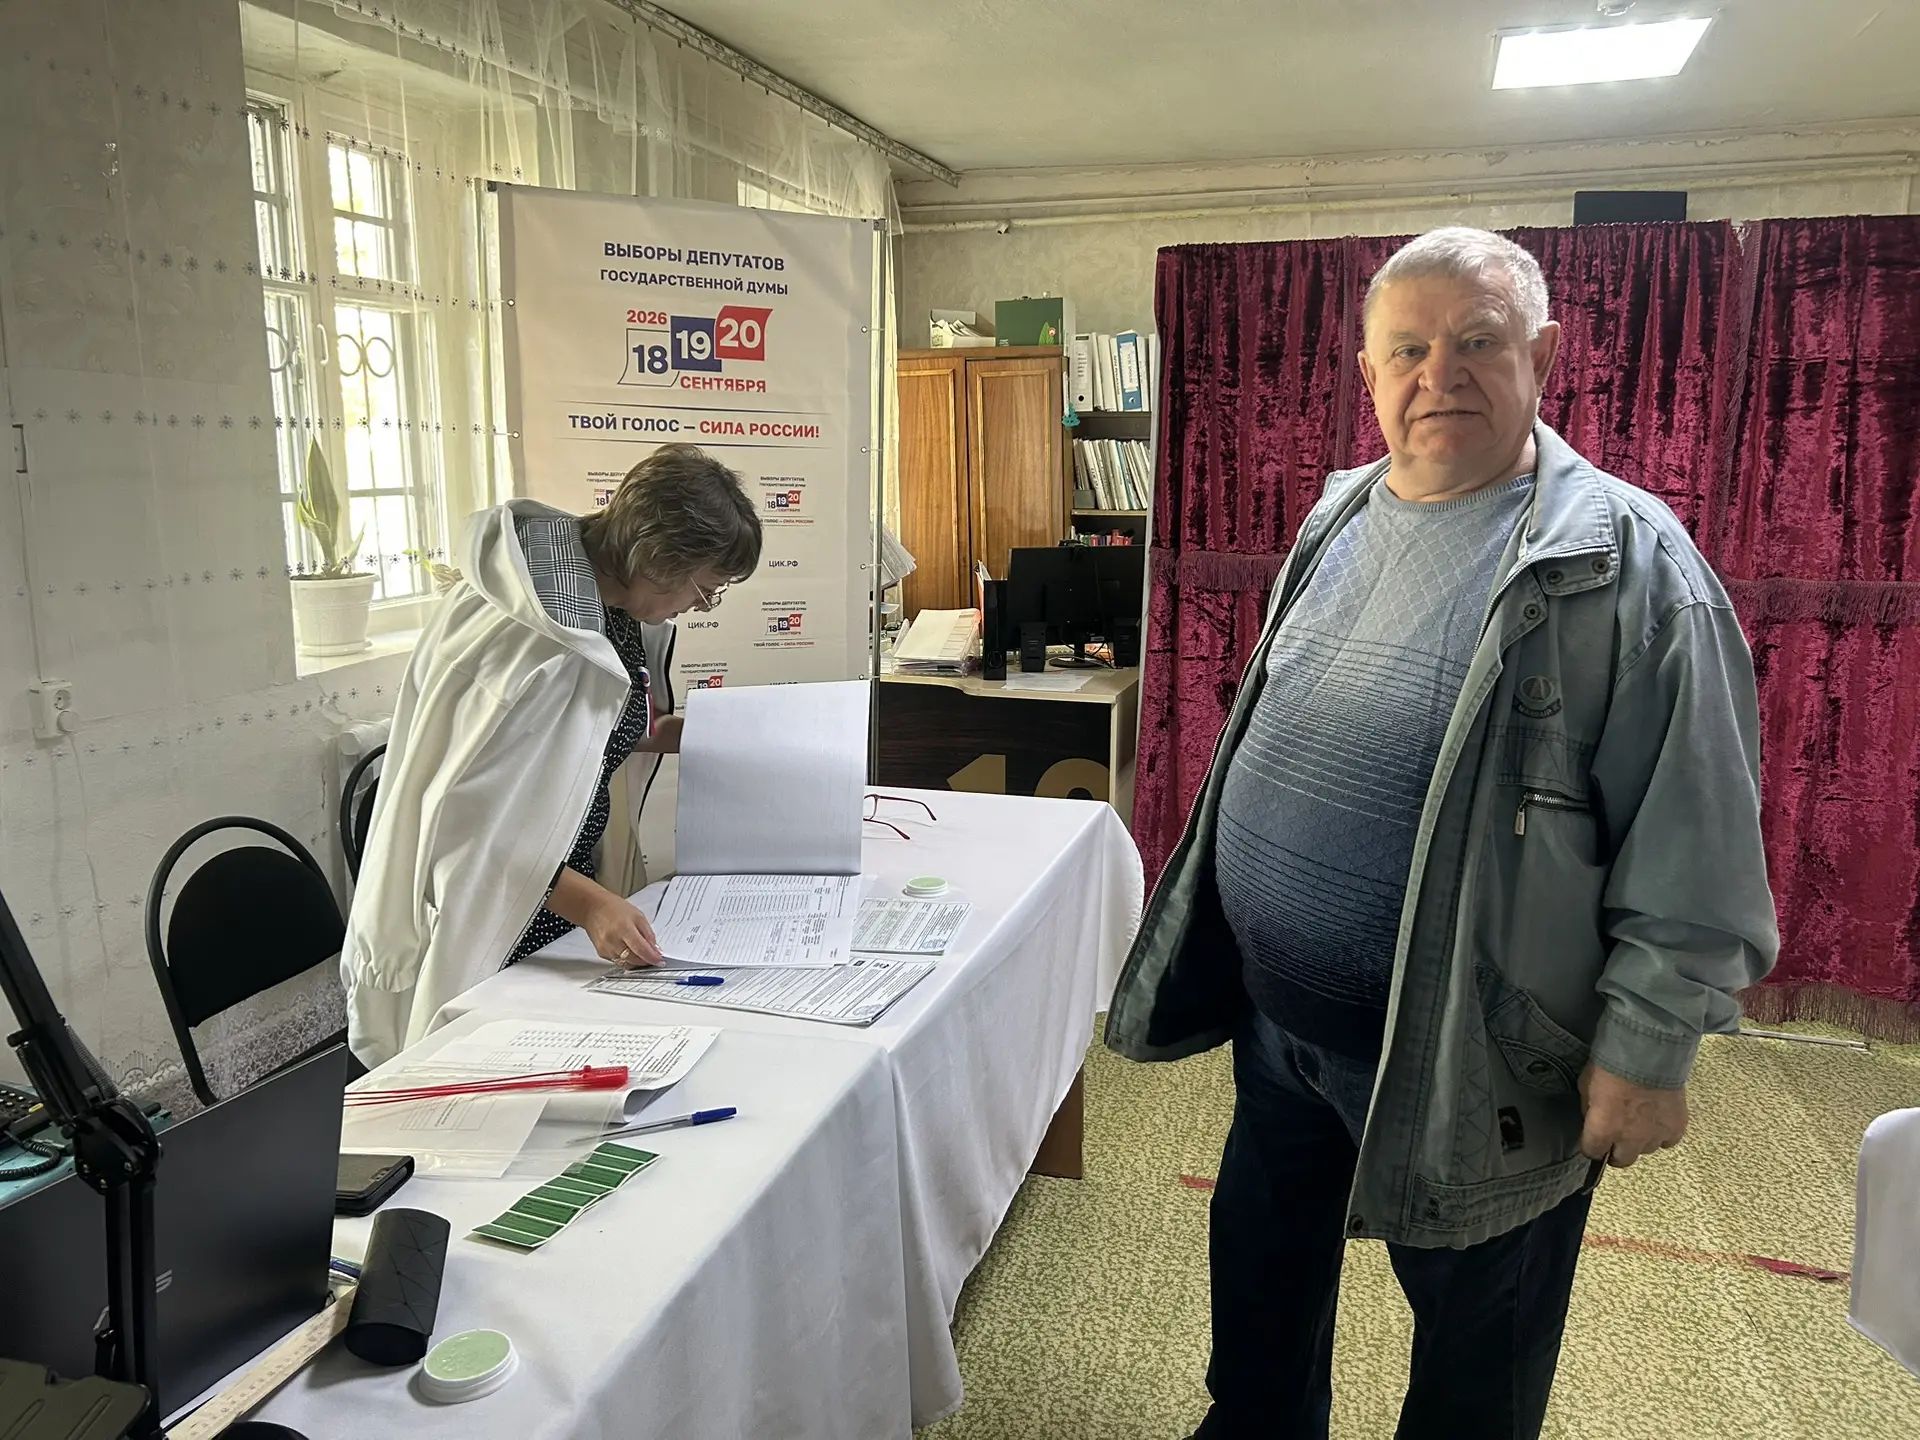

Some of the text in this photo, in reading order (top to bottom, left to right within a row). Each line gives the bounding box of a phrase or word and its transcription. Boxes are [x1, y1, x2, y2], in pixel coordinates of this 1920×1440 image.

[603, 241, 785, 272] ВЫБОРЫ ДЕПУТАТОВ
[600, 268, 788, 296] ГОСУДАРСТВЕННОЙ ДУМЫ
[626, 309, 668, 326] 2026
[632, 317, 762, 375] 18 19 20
[680, 375, 767, 393] СЕНТЯБРЯ
[568, 412, 617, 431] ТВОЙ
[621, 416, 680, 433] ГОЛОС
[699, 420, 745, 436] СИЛА
[749, 421, 820, 439] РОССИИ!
[596, 497, 606, 506] 18
[767, 493, 799, 509] 18 19 20
[768, 560, 799, 568] ЦИК.РФ
[687, 621, 719, 629] ЦИК.РФ
[769, 616, 800, 633] 18 19 20
[709, 678, 721, 687] 20
